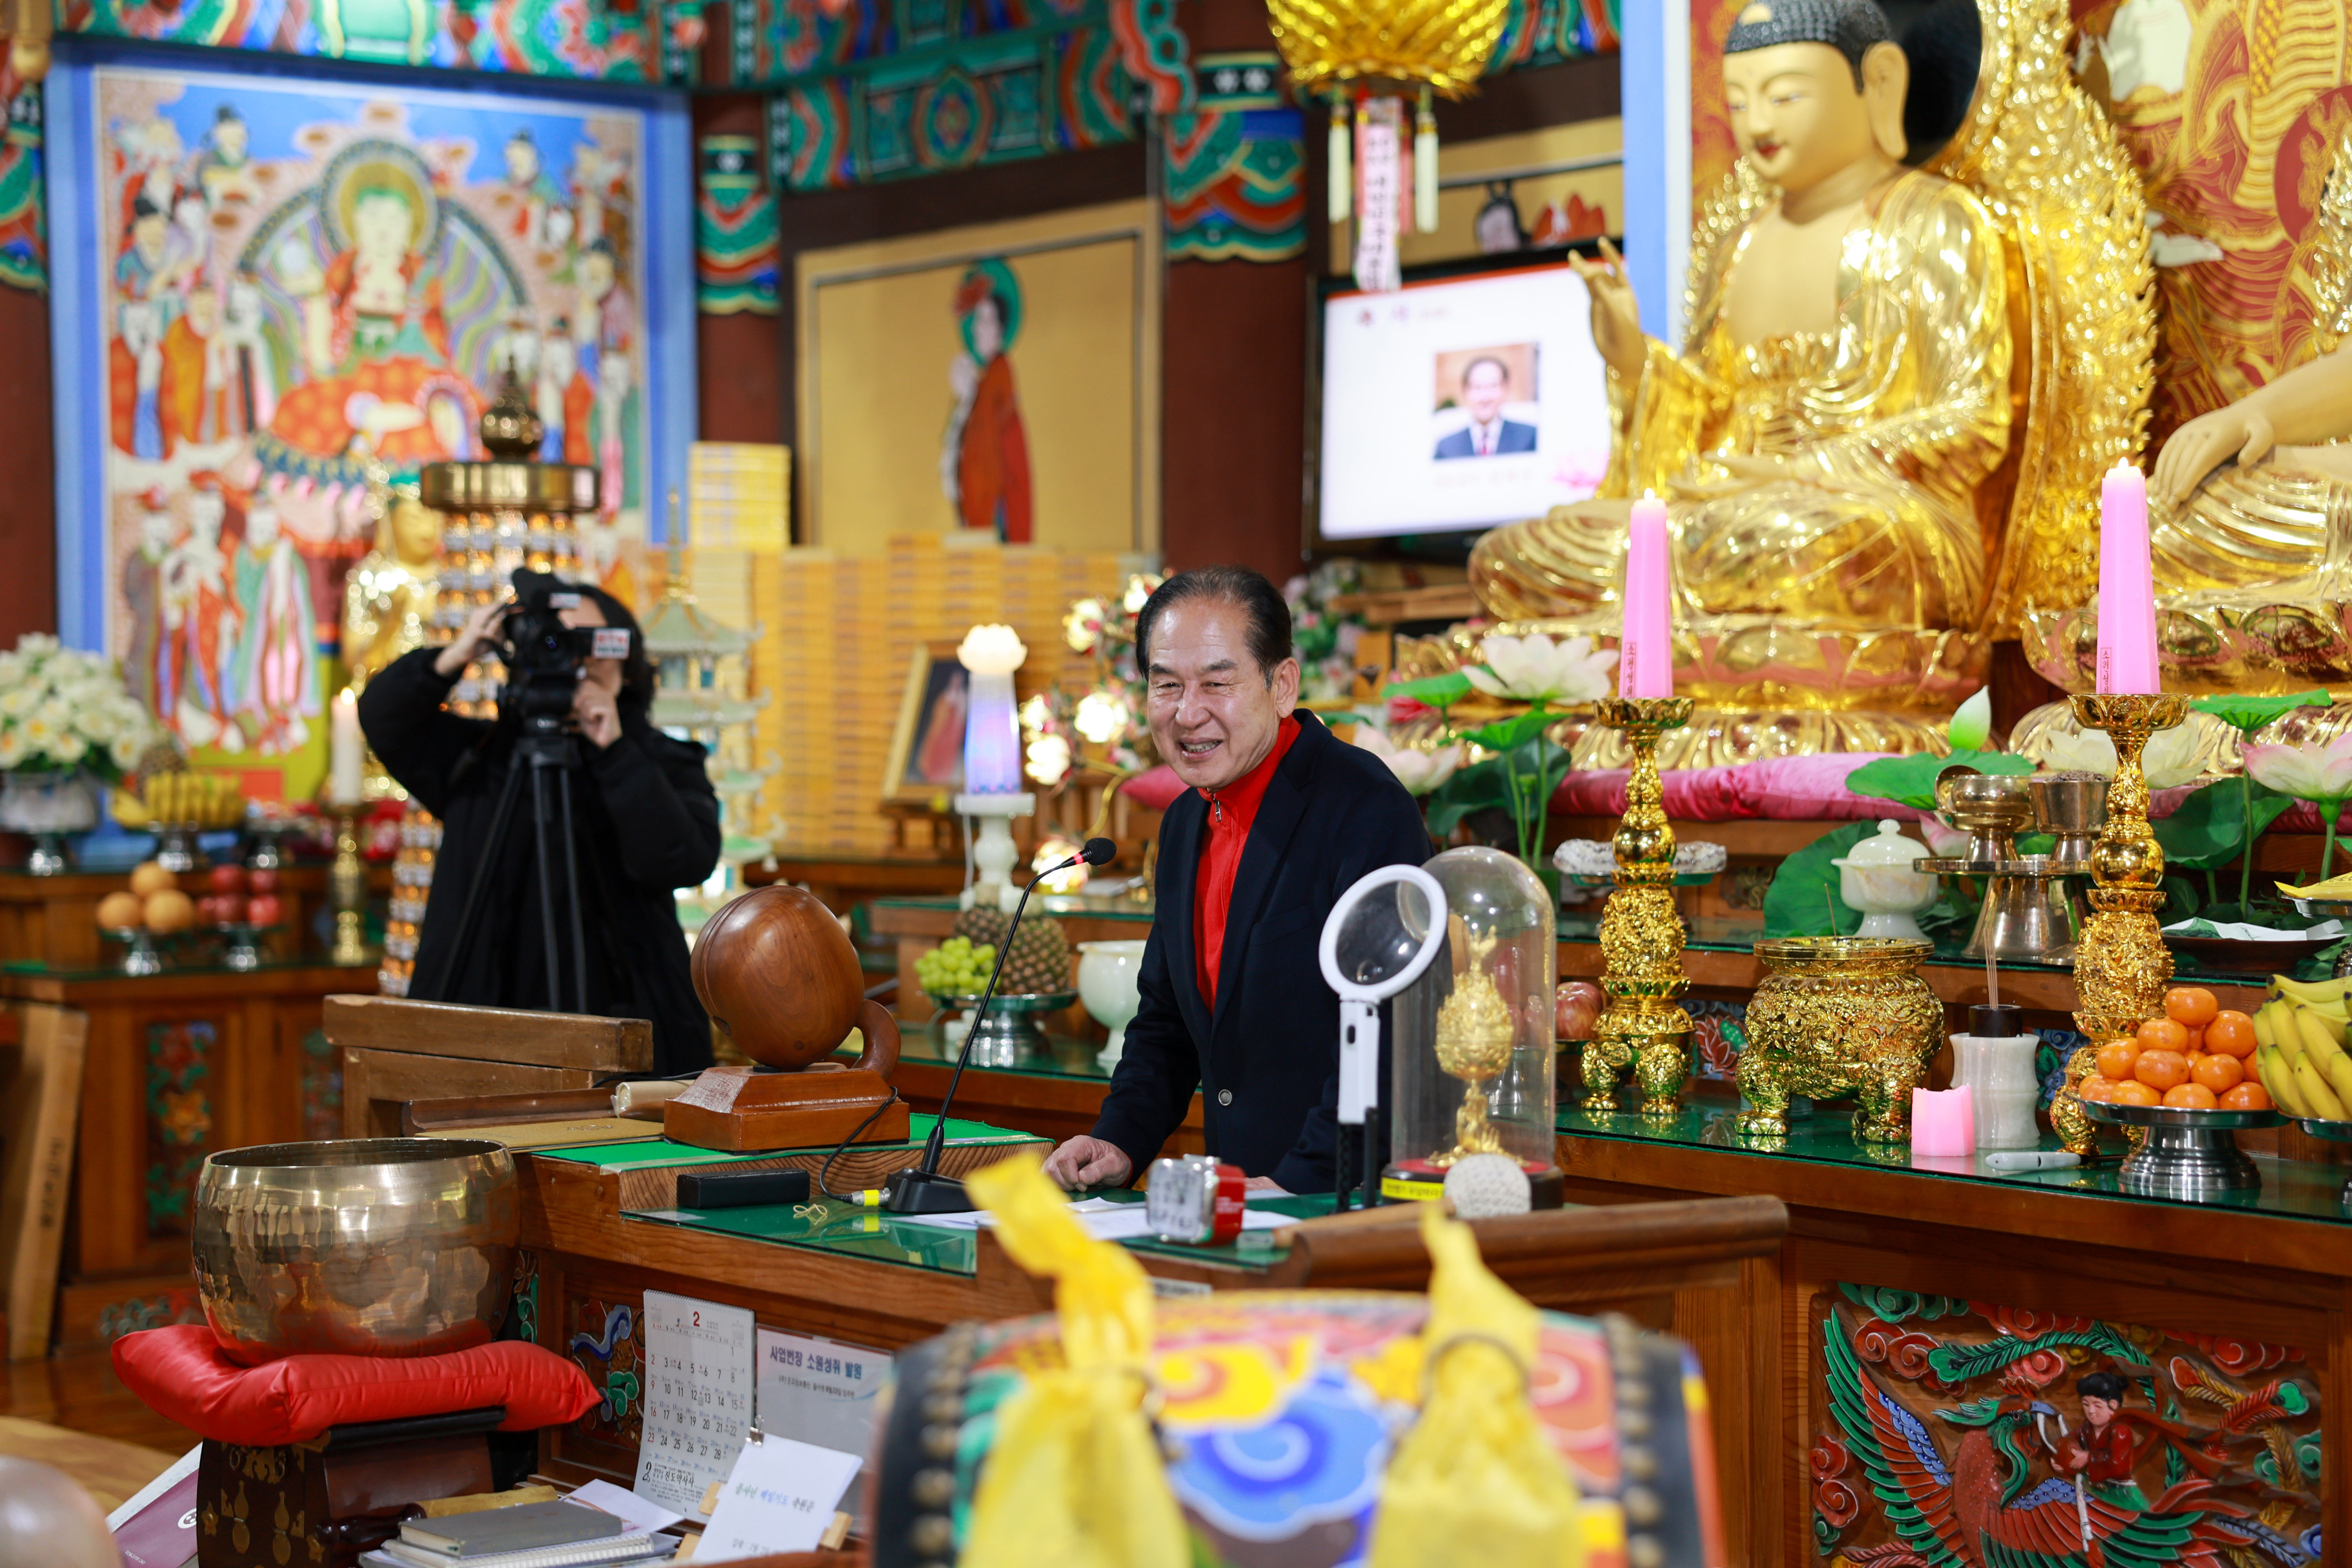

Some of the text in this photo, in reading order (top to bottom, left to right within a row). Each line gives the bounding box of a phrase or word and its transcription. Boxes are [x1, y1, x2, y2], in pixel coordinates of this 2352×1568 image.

[693, 1311, 700, 1327] 2
[731, 1346, 733, 1356] 1
[652, 1355, 655, 1364] 2
[665, 1357, 668, 1367] 3
[677, 1361, 681, 1370] 4
[691, 1363, 694, 1373] 5
[704, 1367, 708, 1376] 6
[718, 1369, 721, 1379] 7
[731, 1372, 735, 1383] 8
[807, 1354, 840, 1375] 소원성취
[845, 1361, 862, 1379] 발원
[652, 1380, 737, 1410] 9 10 11 12 13 14 15
[651, 1406, 737, 1436] 16 17 18 19 20 21 22
[648, 1432, 721, 1459] 23 24 25 26 27 28
[664, 1471, 695, 1487] 진도약사사
[760, 1490, 789, 1505] 백일기도
